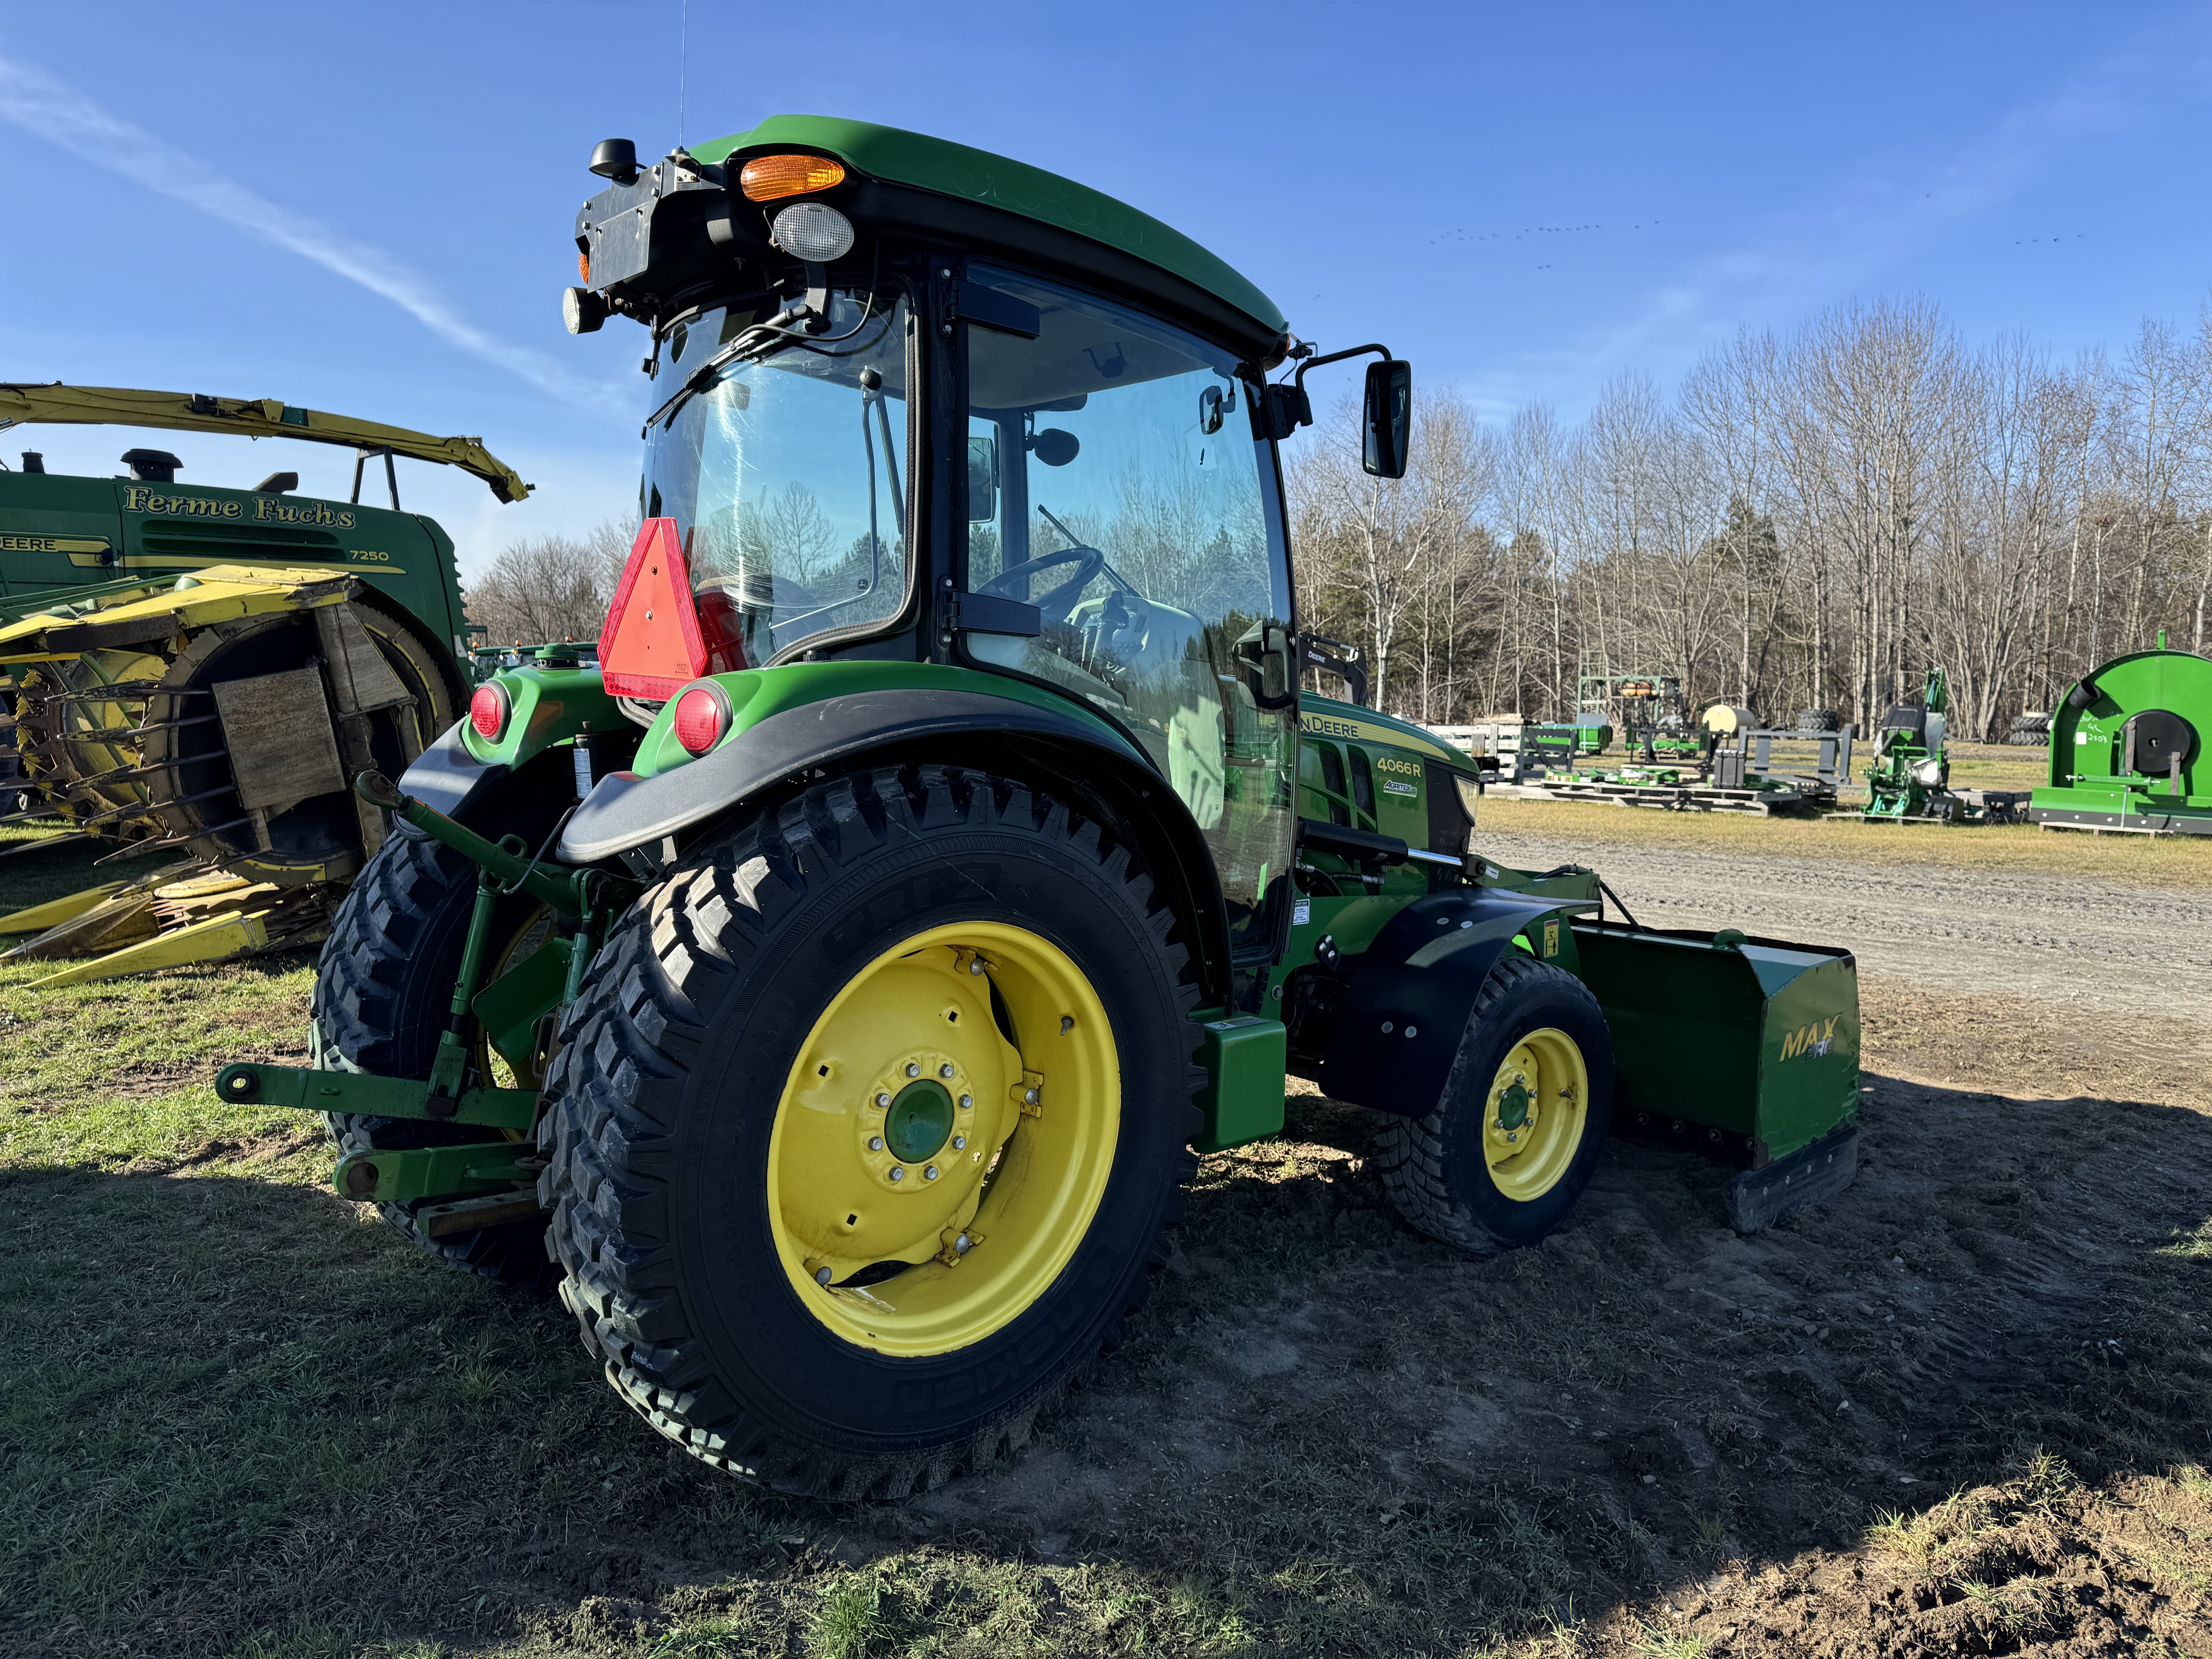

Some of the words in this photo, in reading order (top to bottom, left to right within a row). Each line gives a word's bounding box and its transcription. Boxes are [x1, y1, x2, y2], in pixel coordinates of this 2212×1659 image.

[125, 487, 241, 519] Ferme
[254, 497, 354, 528] Fuchs
[0, 537, 56, 550] EERE
[349, 550, 389, 562] 7250
[1312, 716, 1359, 738] DEERE
[1385, 781, 1410, 791] AGRITEX
[1096, 883, 1146, 945] ROTATION
[1779, 1012, 1842, 1063] MAX
[685, 1058, 721, 1171] ROTATION
